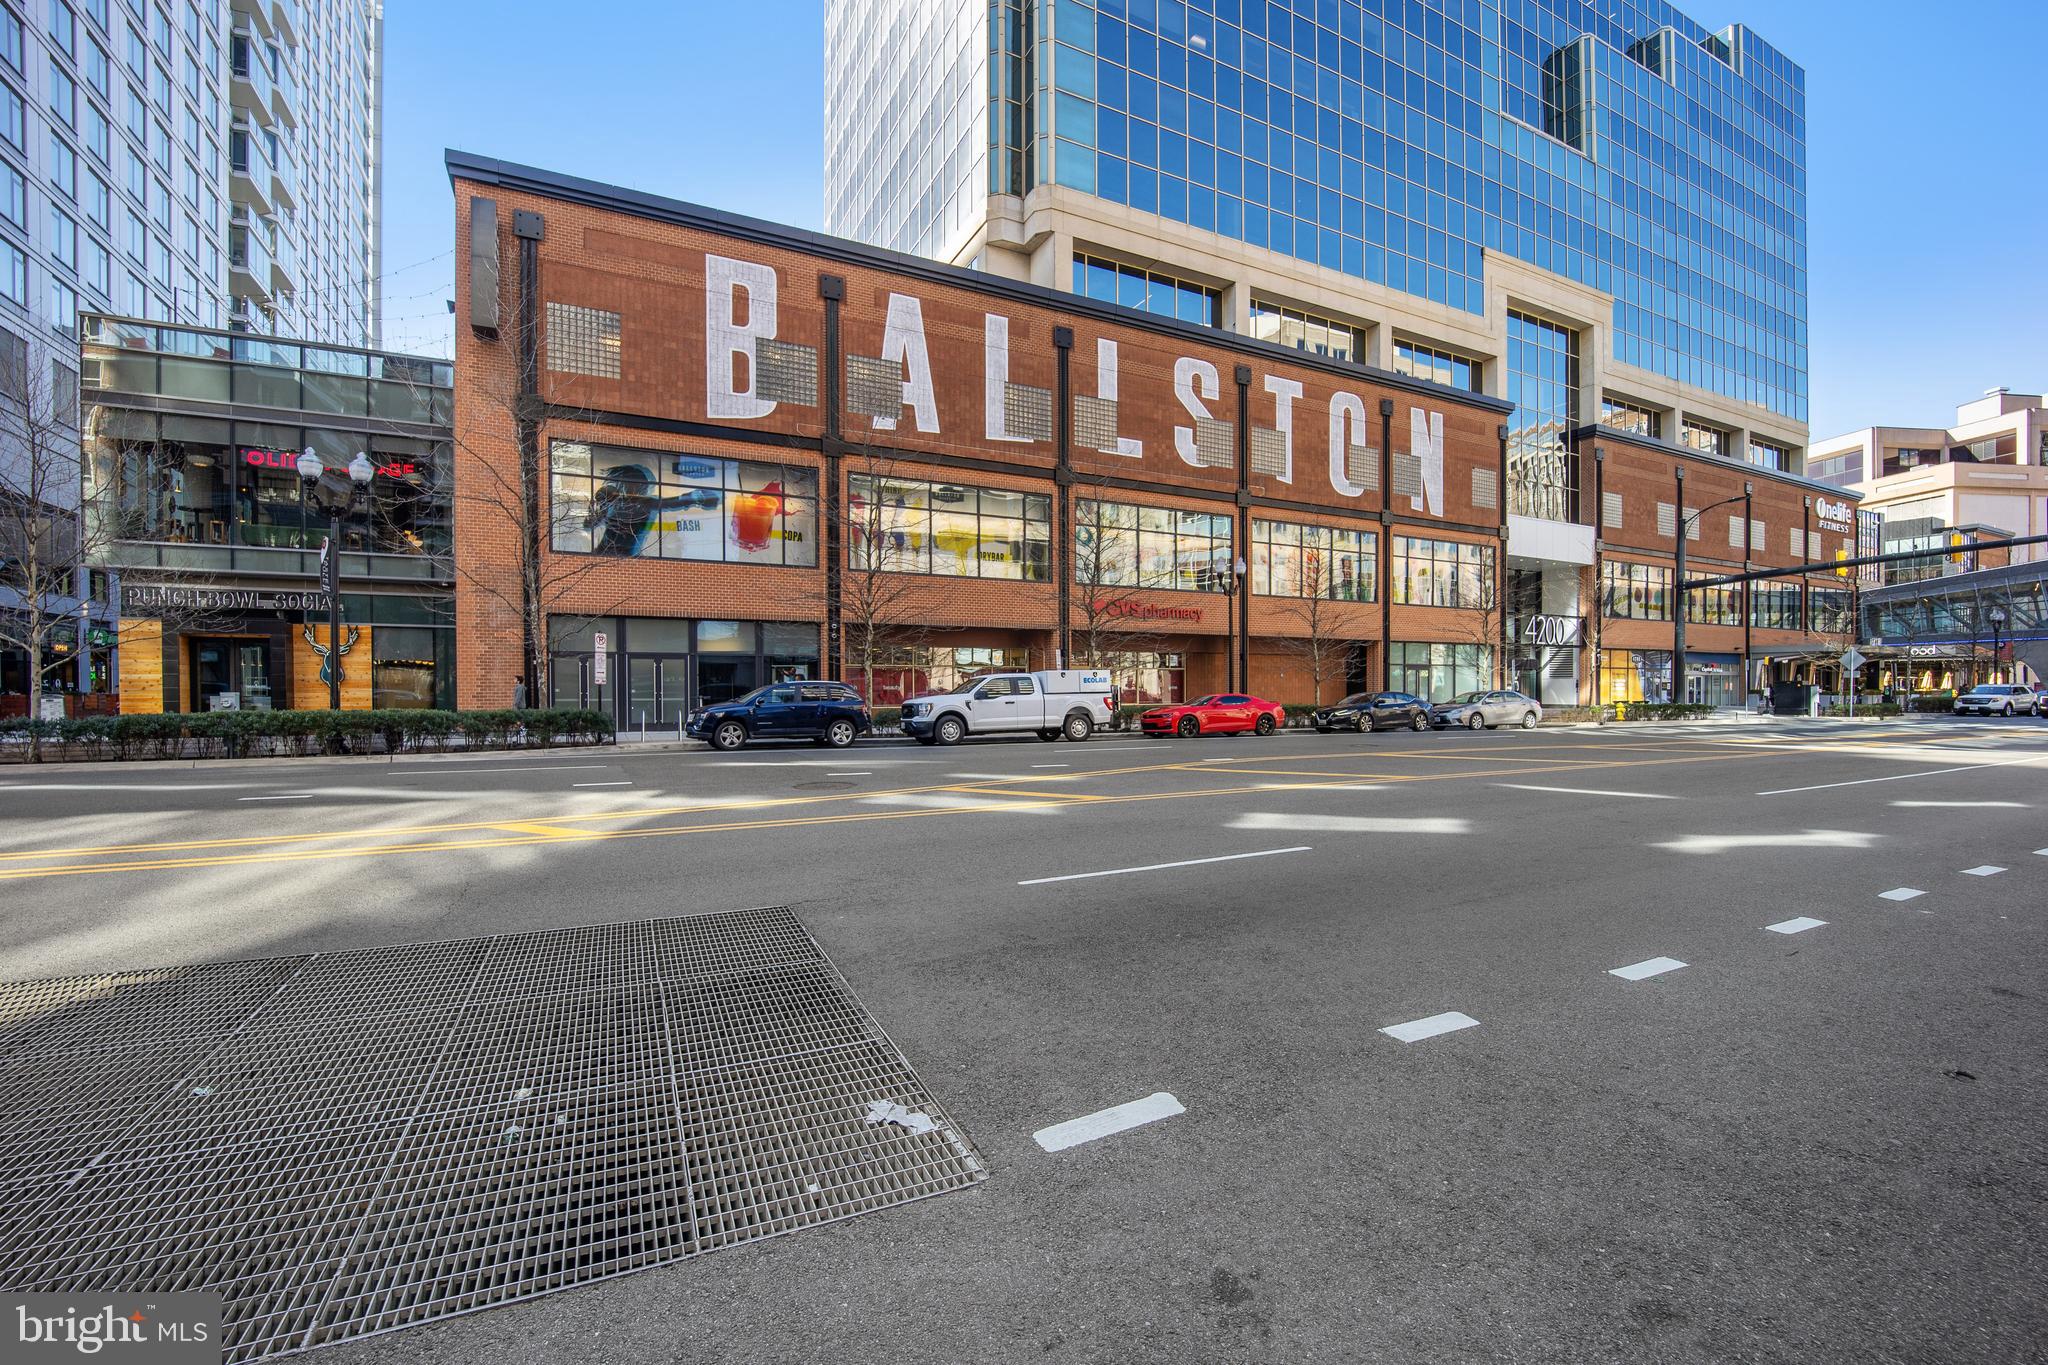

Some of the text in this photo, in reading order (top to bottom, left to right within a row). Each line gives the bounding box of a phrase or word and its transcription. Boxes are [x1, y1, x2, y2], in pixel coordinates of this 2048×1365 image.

[704, 253, 1444, 518] BALLSTON
[1815, 497, 1852, 524] Onelife
[676, 520, 701, 532] BASH
[783, 529, 803, 542] COPA
[1818, 520, 1849, 534] FITNESS
[128, 586, 344, 612] PUNCH BOWL SOCIA
[1108, 601, 1203, 623] CVS pharmacy
[1524, 615, 1566, 646] 4200
[1905, 645, 1936, 656] ood
